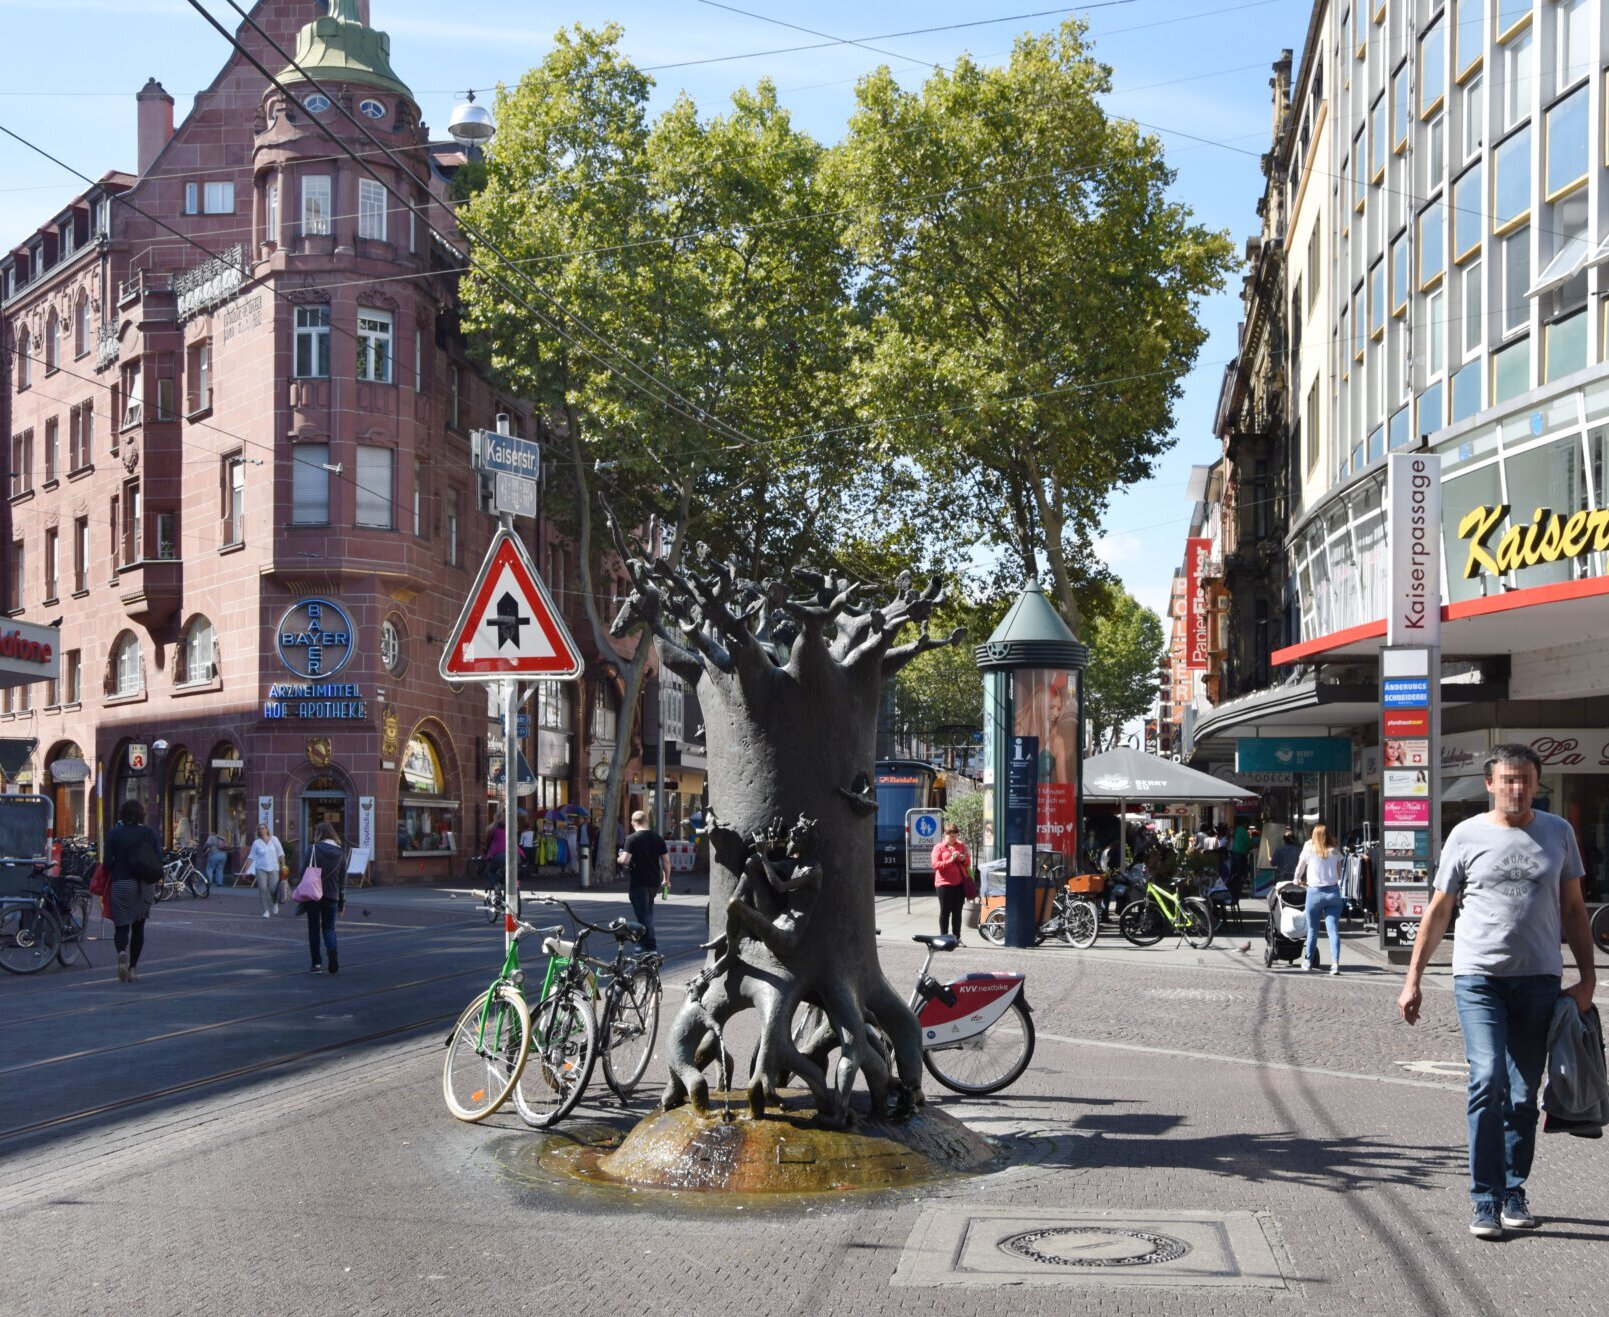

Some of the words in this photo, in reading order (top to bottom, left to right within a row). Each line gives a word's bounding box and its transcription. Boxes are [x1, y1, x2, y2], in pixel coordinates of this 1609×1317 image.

[487, 439, 537, 471] Kaiserstr.
[1405, 459, 1431, 629] Kaiserpassage
[1458, 503, 1609, 579] Kaiser
[0, 629, 52, 663] afone
[282, 632, 347, 645] BAYER
[308, 604, 320, 673] BAYER
[1384, 682, 1428, 691] ÄNDERUNGS
[1384, 693, 1428, 702] SCHNEIDEREI
[264, 702, 288, 718] HOF
[300, 702, 366, 718] APOTHEKE
[1501, 854, 1531, 866] WORK
[959, 985, 978, 993] KVV
[978, 983, 1009, 992] nextbike
